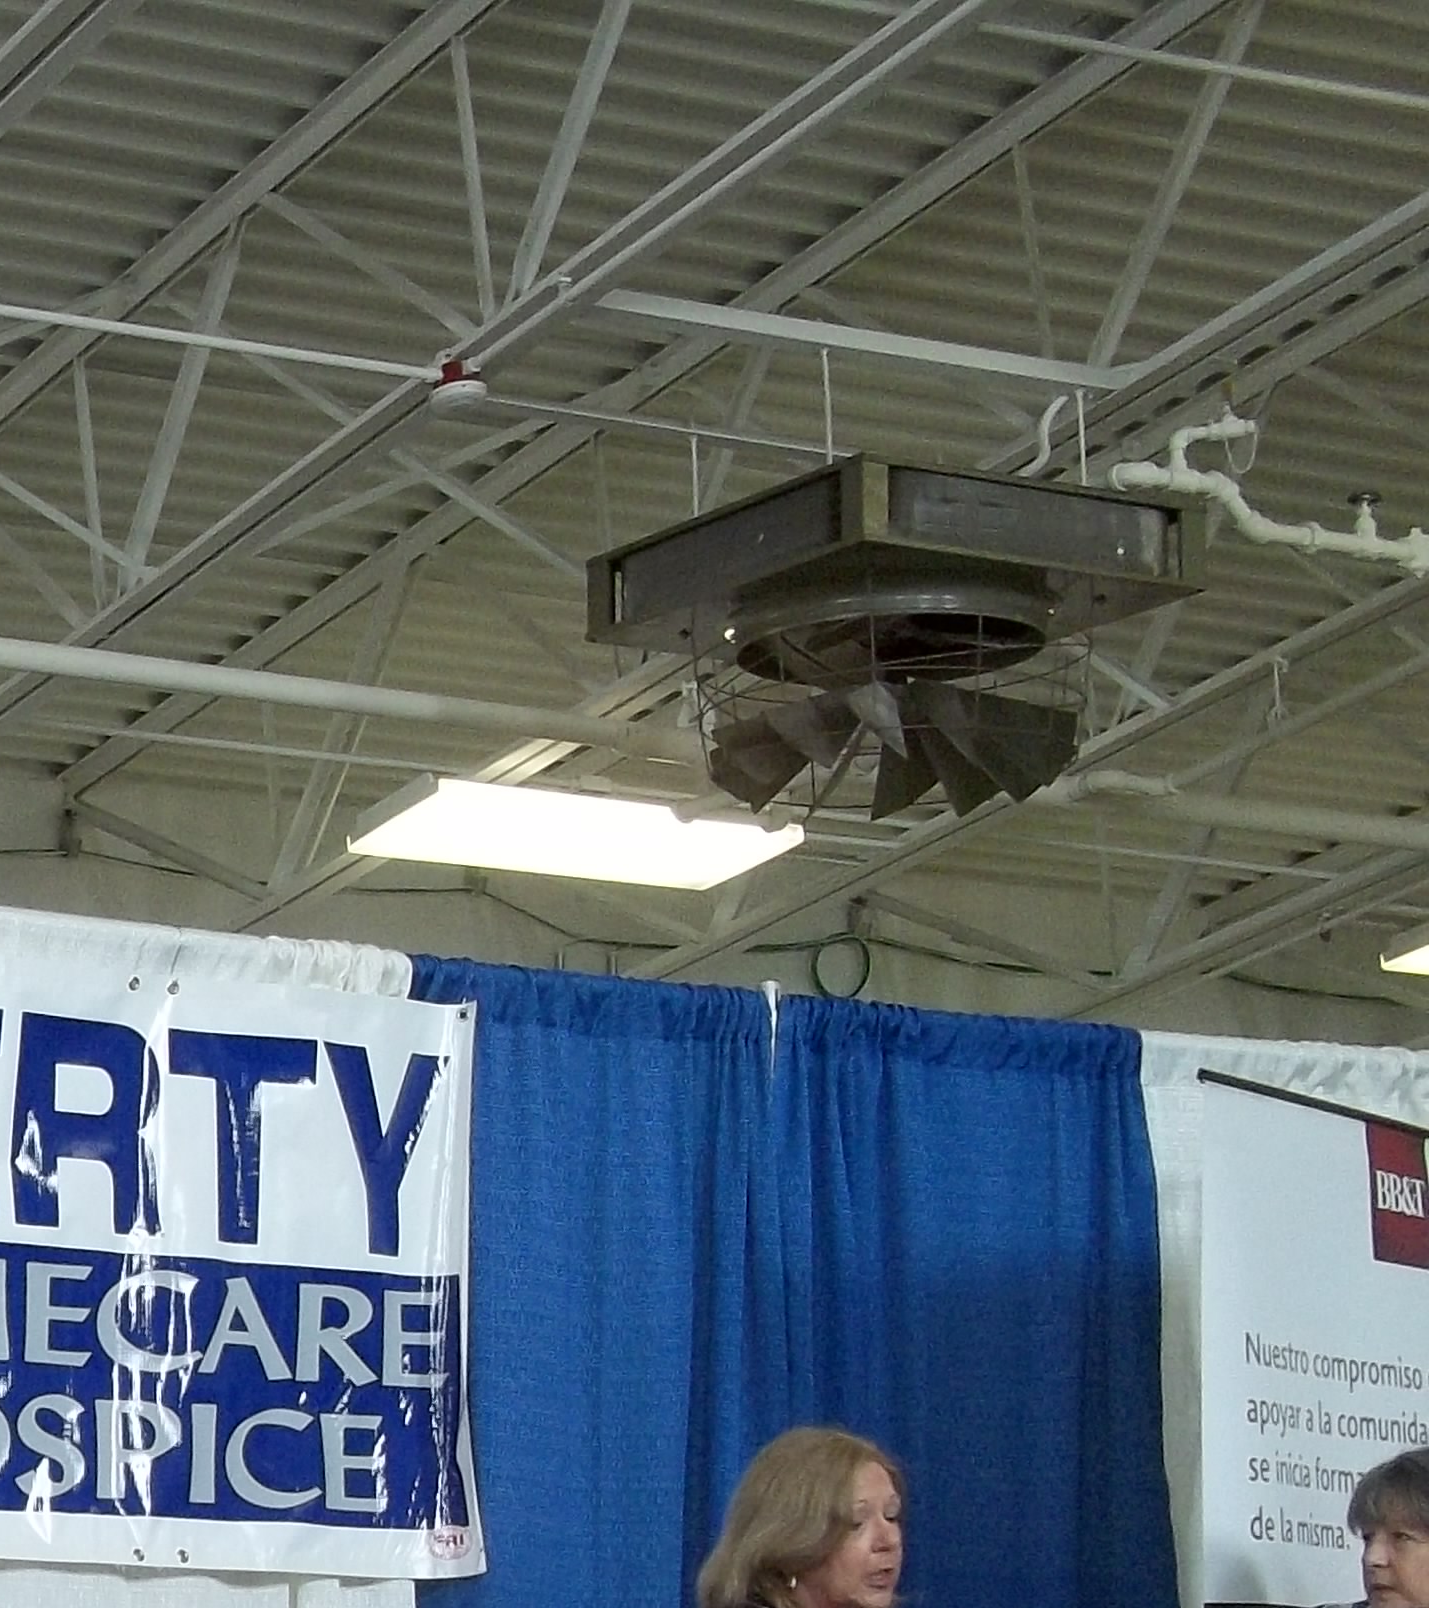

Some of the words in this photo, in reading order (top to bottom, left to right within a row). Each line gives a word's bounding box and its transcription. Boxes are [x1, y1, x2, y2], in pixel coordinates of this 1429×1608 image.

[1375, 1168, 1426, 1219] BB&T
[1245, 1331, 1309, 1375] Nuestro
[1313, 1355, 1423, 1393] compromiso
[1246, 1398, 1302, 1438] apoyar
[1305, 1407, 1314, 1433] a
[1318, 1399, 1332, 1435] la
[1248, 1457, 1270, 1482] se
[1275, 1450, 1311, 1488] inicia
[1315, 1456, 1365, 1494] form
[1250, 1504, 1275, 1541] de
[1280, 1506, 1293, 1543] la
[1297, 1511, 1350, 1550] misma.
